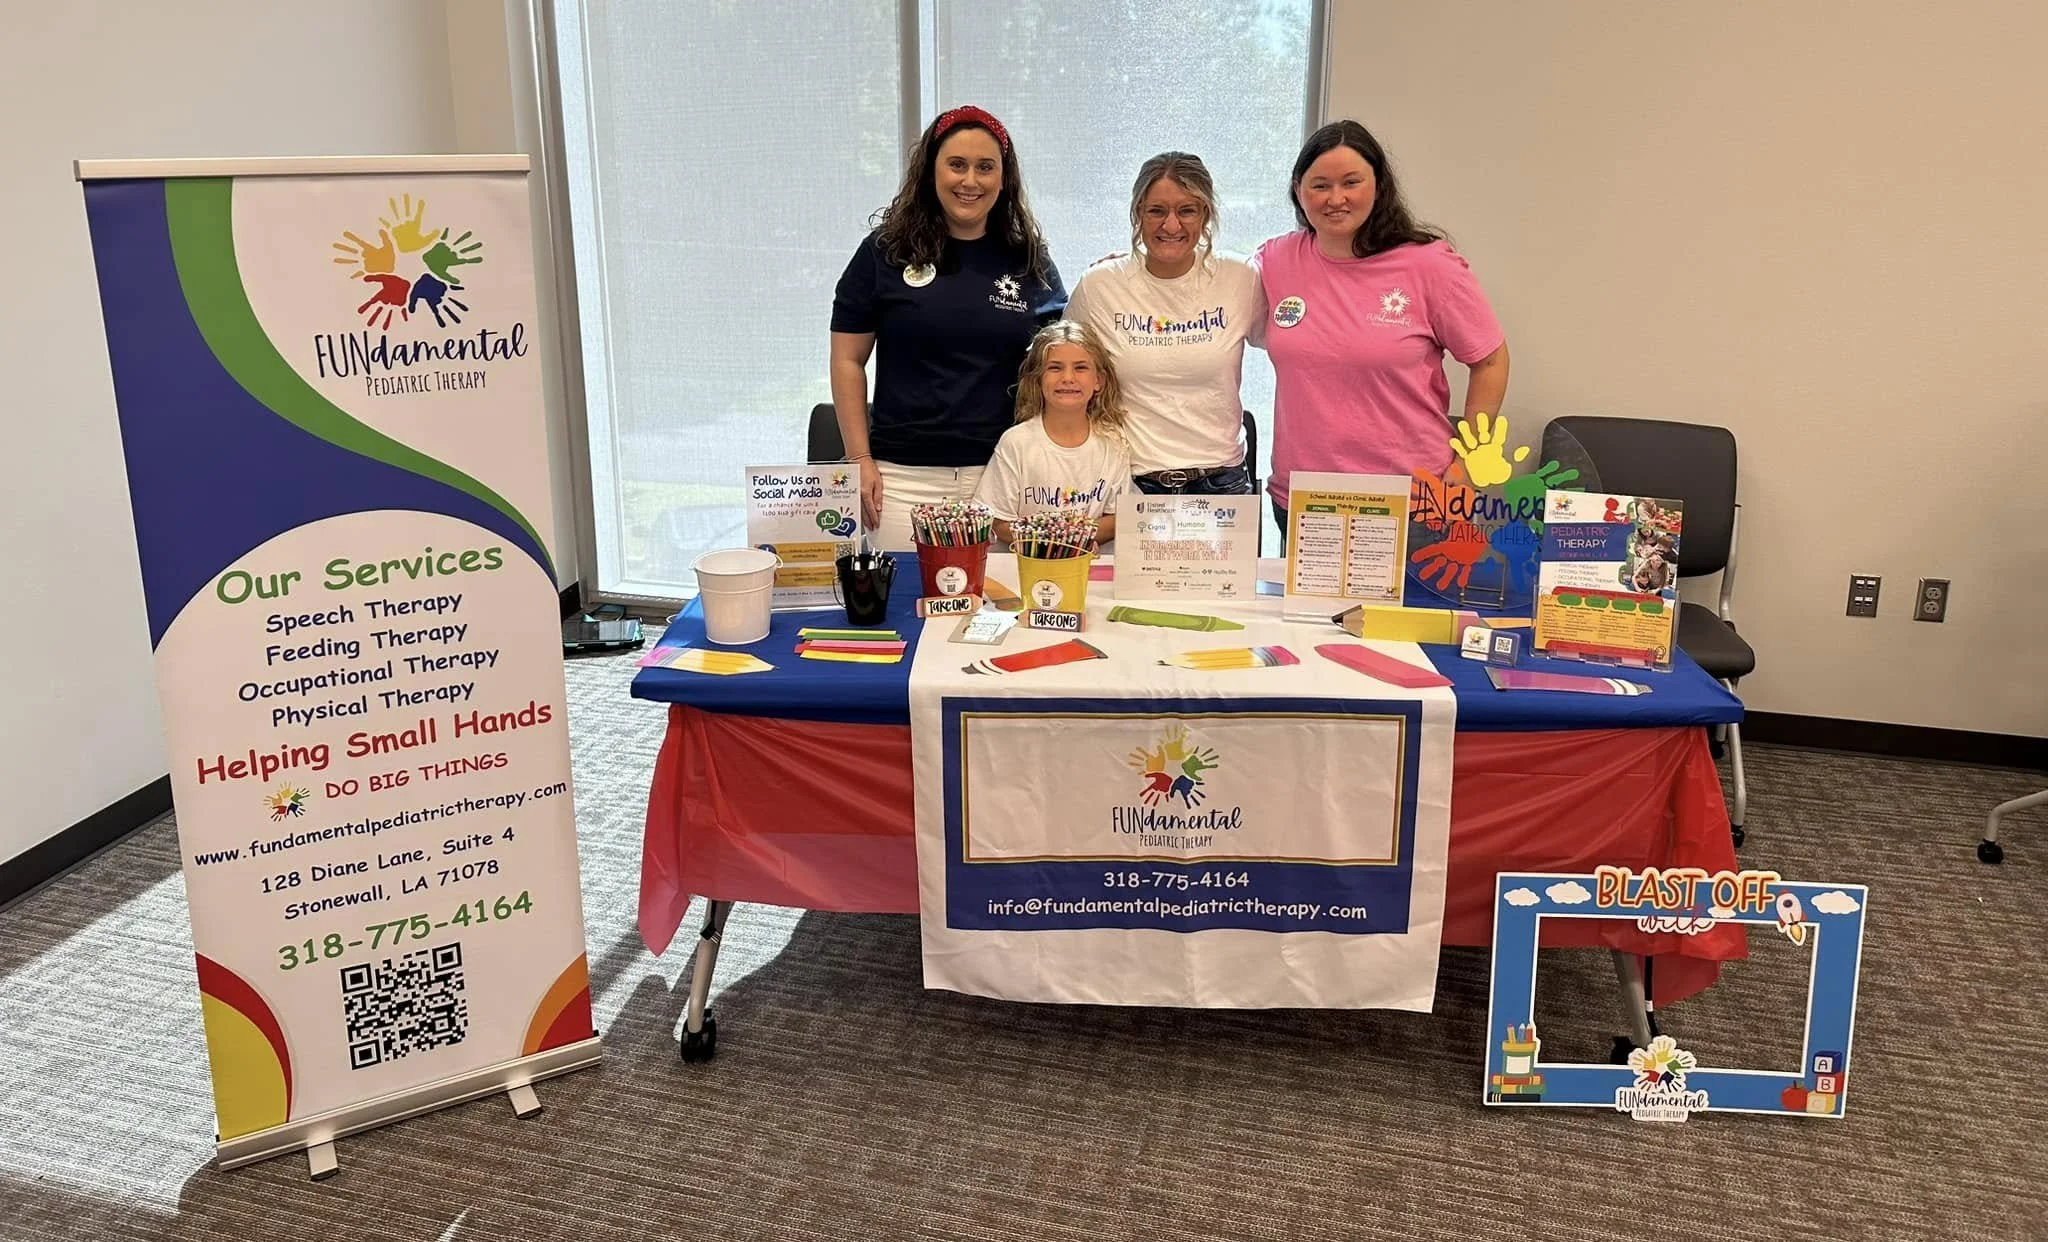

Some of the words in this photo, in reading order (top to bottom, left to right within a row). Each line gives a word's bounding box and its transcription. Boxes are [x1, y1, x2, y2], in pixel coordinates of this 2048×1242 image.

[314, 322, 528, 378] FUNdamental
[1128, 335, 1173, 347] PEDIATRIC
[1176, 333, 1213, 345] THERAPY
[366, 373, 432, 397] PEDIATRIC
[434, 370, 488, 394] THERAPY
[752, 475, 788, 486] Follow
[791, 476, 803, 485] Us
[805, 476, 820, 485] on
[752, 488, 784, 499] Social
[788, 487, 823, 499] Media
[1551, 526, 1610, 537] PEDIATRIC
[1556, 539, 1607, 549] THERAPY
[216, 569, 301, 604] Our
[324, 546, 503, 591] Services
[265, 605, 354, 635] Speech
[364, 594, 463, 620] Therapy
[266, 637, 361, 666] Feeding
[370, 623, 468, 650] Therapy
[238, 661, 393, 701] Occupational
[403, 648, 499, 675] Therapy
[272, 695, 368, 727] Physical
[378, 681, 475, 710] Therapy
[197, 742, 330, 784] Helping
[346, 717, 437, 758] Small
[453, 699, 553, 738] Hands
[325, 778, 359, 799] DO
[369, 770, 410, 792] BIG
[418, 752, 509, 782] THINGS
[195, 781, 567, 866] www.fundamentalpediatrictherapy.com
[1112, 806, 1243, 835] FUNdamental
[1139, 833, 1179, 849] PEDIATRIC
[1181, 834, 1213, 849] THERAPY
[261, 872, 302, 894] 128
[311, 859, 369, 882] Diane
[377, 848, 432, 870] Lane,
[441, 832, 494, 856] Suite
[502, 826, 515, 843] 4
[284, 883, 391, 920] Stonewall,
[402, 876, 428, 895] LA
[437, 859, 500, 887] 71078
[1103, 871, 1250, 890] 318-775-4164
[1598, 871, 1704, 909] BLAST
[1713, 876, 1777, 912] OFF
[987, 896, 1367, 920] info@fundamentalpediatrictherapy.com
[278, 891, 534, 971] 318-775-4164
[1818, 1059, 1828, 1071] A
[1619, 1090, 1706, 1109] FUNdamental
[1821, 1078, 1831, 1091] B
